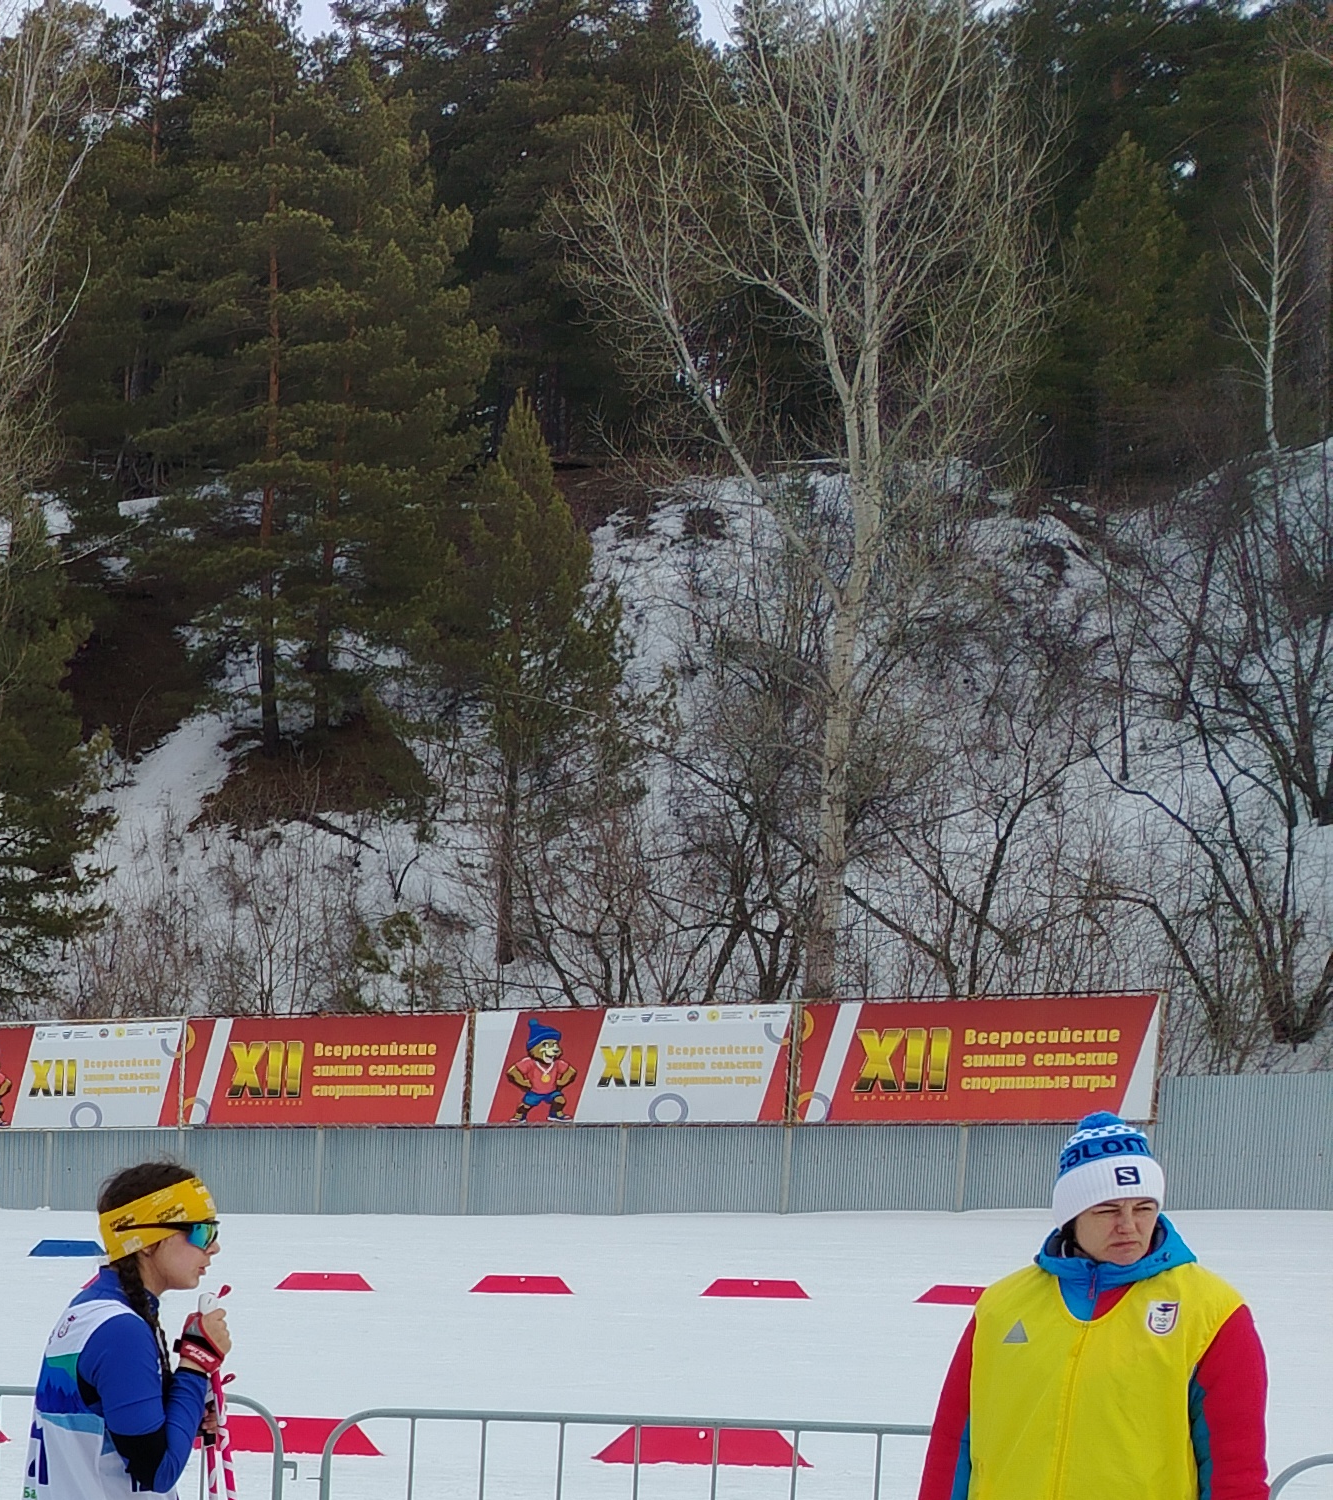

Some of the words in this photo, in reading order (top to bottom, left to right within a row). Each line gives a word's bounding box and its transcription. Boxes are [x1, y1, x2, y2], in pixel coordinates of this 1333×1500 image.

[964, 1027, 1121, 1048] Всероссийские
[314, 1041, 437, 1060] Всероссийские
[667, 1044, 764, 1057] Всероссийские
[851, 1027, 953, 1092] XII
[962, 1053, 1026, 1068] зимние
[1033, 1051, 1118, 1067] сельские
[83, 1058, 161, 1070] Всероссийские
[225, 1040, 305, 1098] XII
[312, 1063, 363, 1077] зимние
[368, 1062, 436, 1077] сельские
[597, 1045, 659, 1088] XII
[666, 1060, 706, 1070] зимние
[710, 1059, 763, 1070] сельские
[29, 1059, 77, 1097] XII
[665, 1076, 733, 1087] спортивные
[735, 1075, 762, 1087] игры
[960, 1074, 1070, 1093] спортивные
[1071, 1074, 1117, 1092] игры
[311, 1083, 398, 1100] спортивные
[399, 1083, 435, 1099] игры
